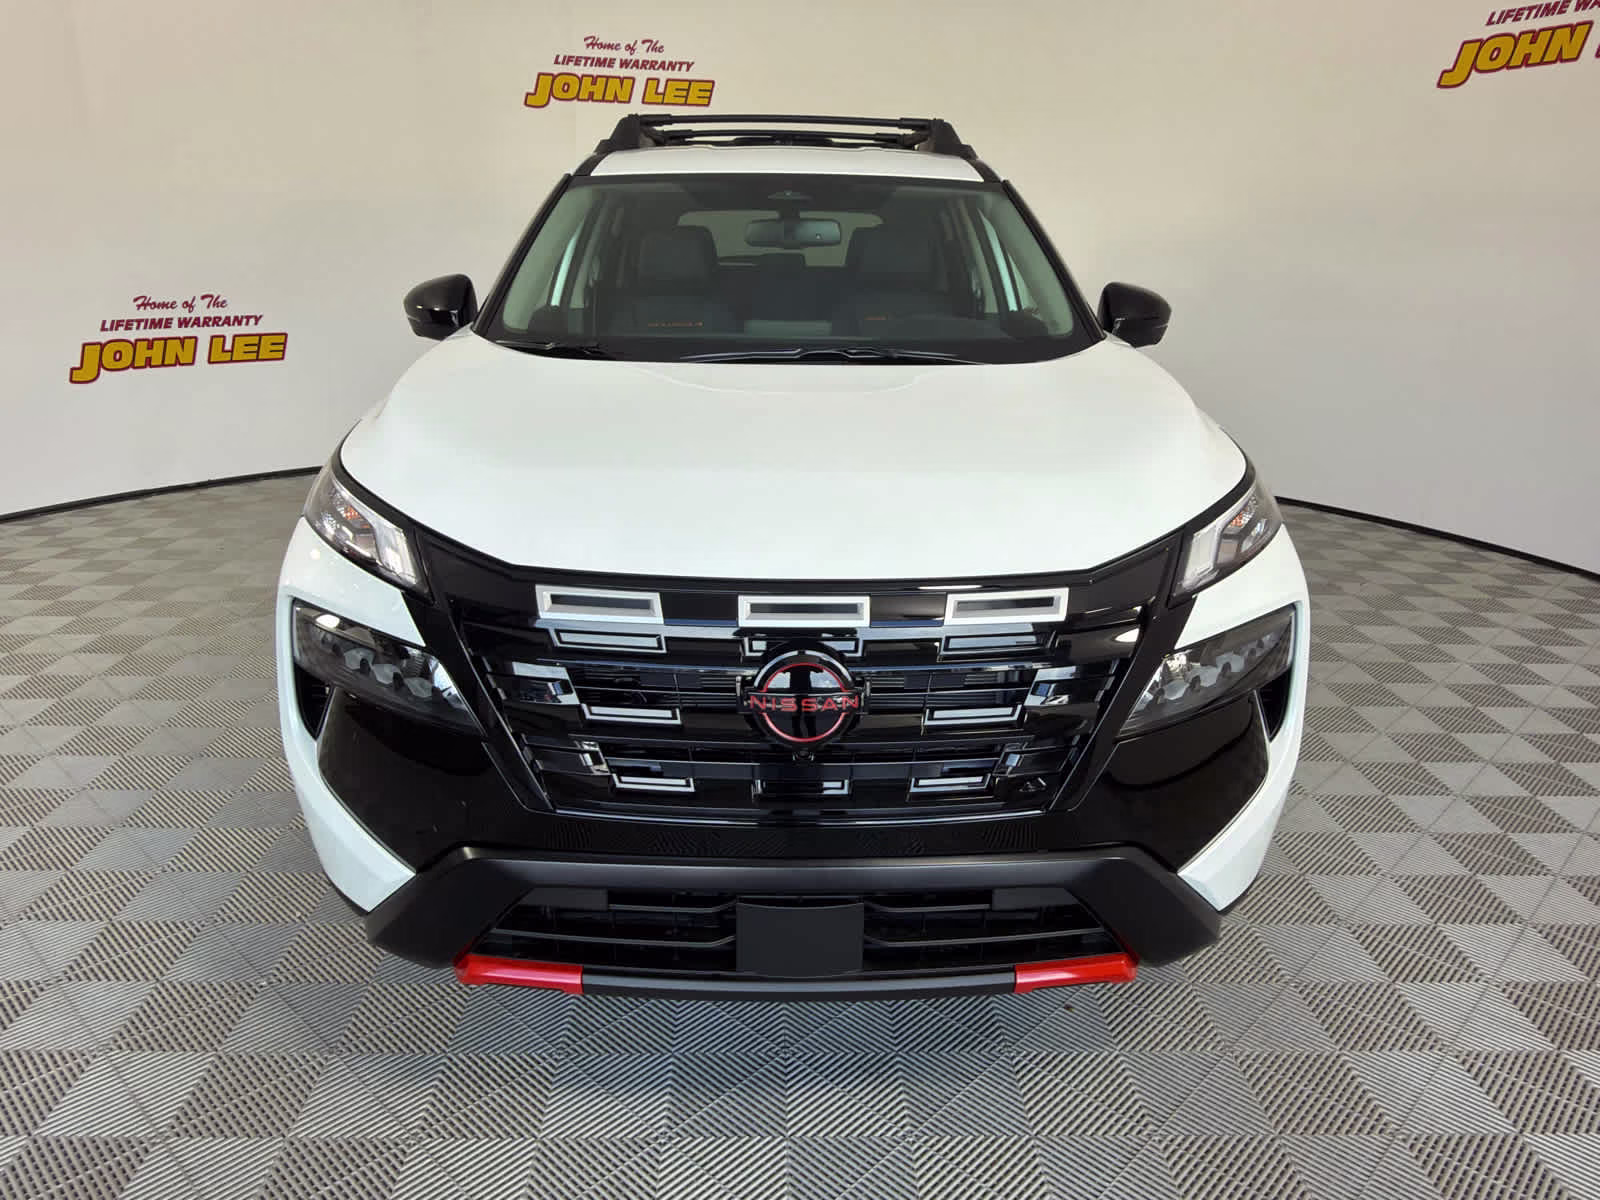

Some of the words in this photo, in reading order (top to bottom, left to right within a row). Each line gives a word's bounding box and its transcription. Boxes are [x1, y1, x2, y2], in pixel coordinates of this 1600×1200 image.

[1485, 0, 1571, 26] LIFETIME
[584, 36, 621, 51] Home
[625, 40, 637, 55] of
[641, 39, 664, 53] The
[1437, 20, 1593, 88] JOHN
[554, 54, 616, 68] LIFETIME
[619, 58, 694, 72] WARRANTY
[524, 72, 636, 108] JOHN
[641, 78, 715, 107] LEE
[133, 295, 177, 310] Home
[182, 296, 196, 313] of
[200, 294, 227, 309] The
[100, 317, 173, 332] LIFETIME
[177, 315, 263, 329] WARRANTY
[69, 336, 198, 384] JOHN
[207, 332, 288, 364] LEE
[750, 695, 859, 712] NISSAN
